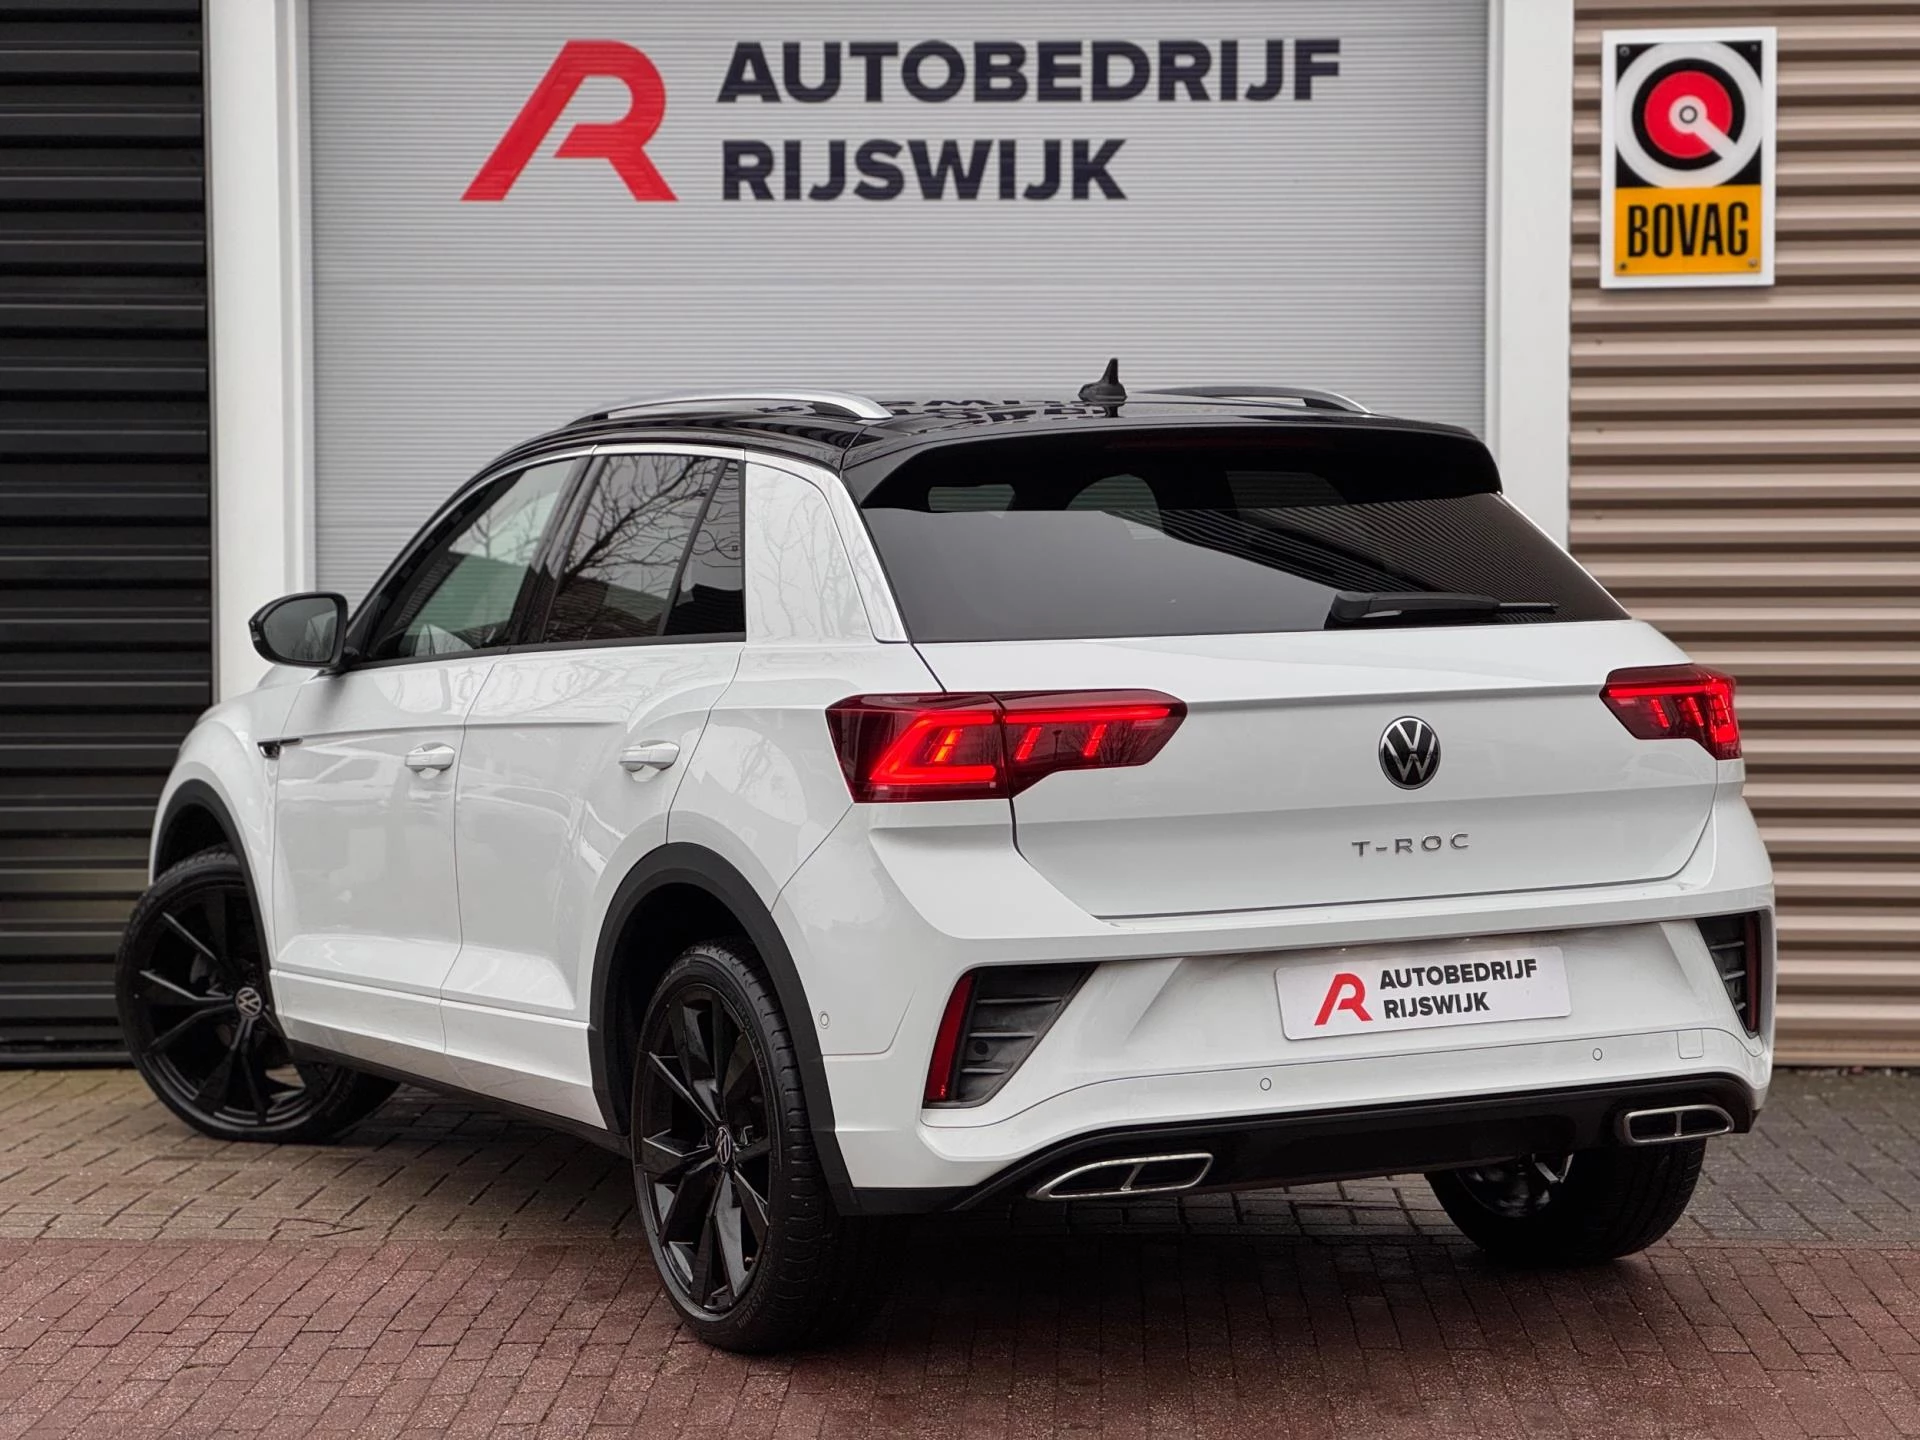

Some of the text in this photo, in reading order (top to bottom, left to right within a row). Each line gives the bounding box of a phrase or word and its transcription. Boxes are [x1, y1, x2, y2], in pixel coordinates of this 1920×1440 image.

[717, 38, 1341, 103] AUTOBEDRIJF
[722, 139, 1126, 201] RIJSWIJK
[1627, 202, 1749, 258] BOVAG
[1351, 833, 1469, 857] T-ROC
[1379, 958, 1537, 990] AUTOBEDRIJF
[1383, 991, 1490, 1019] RIJSWIJK
